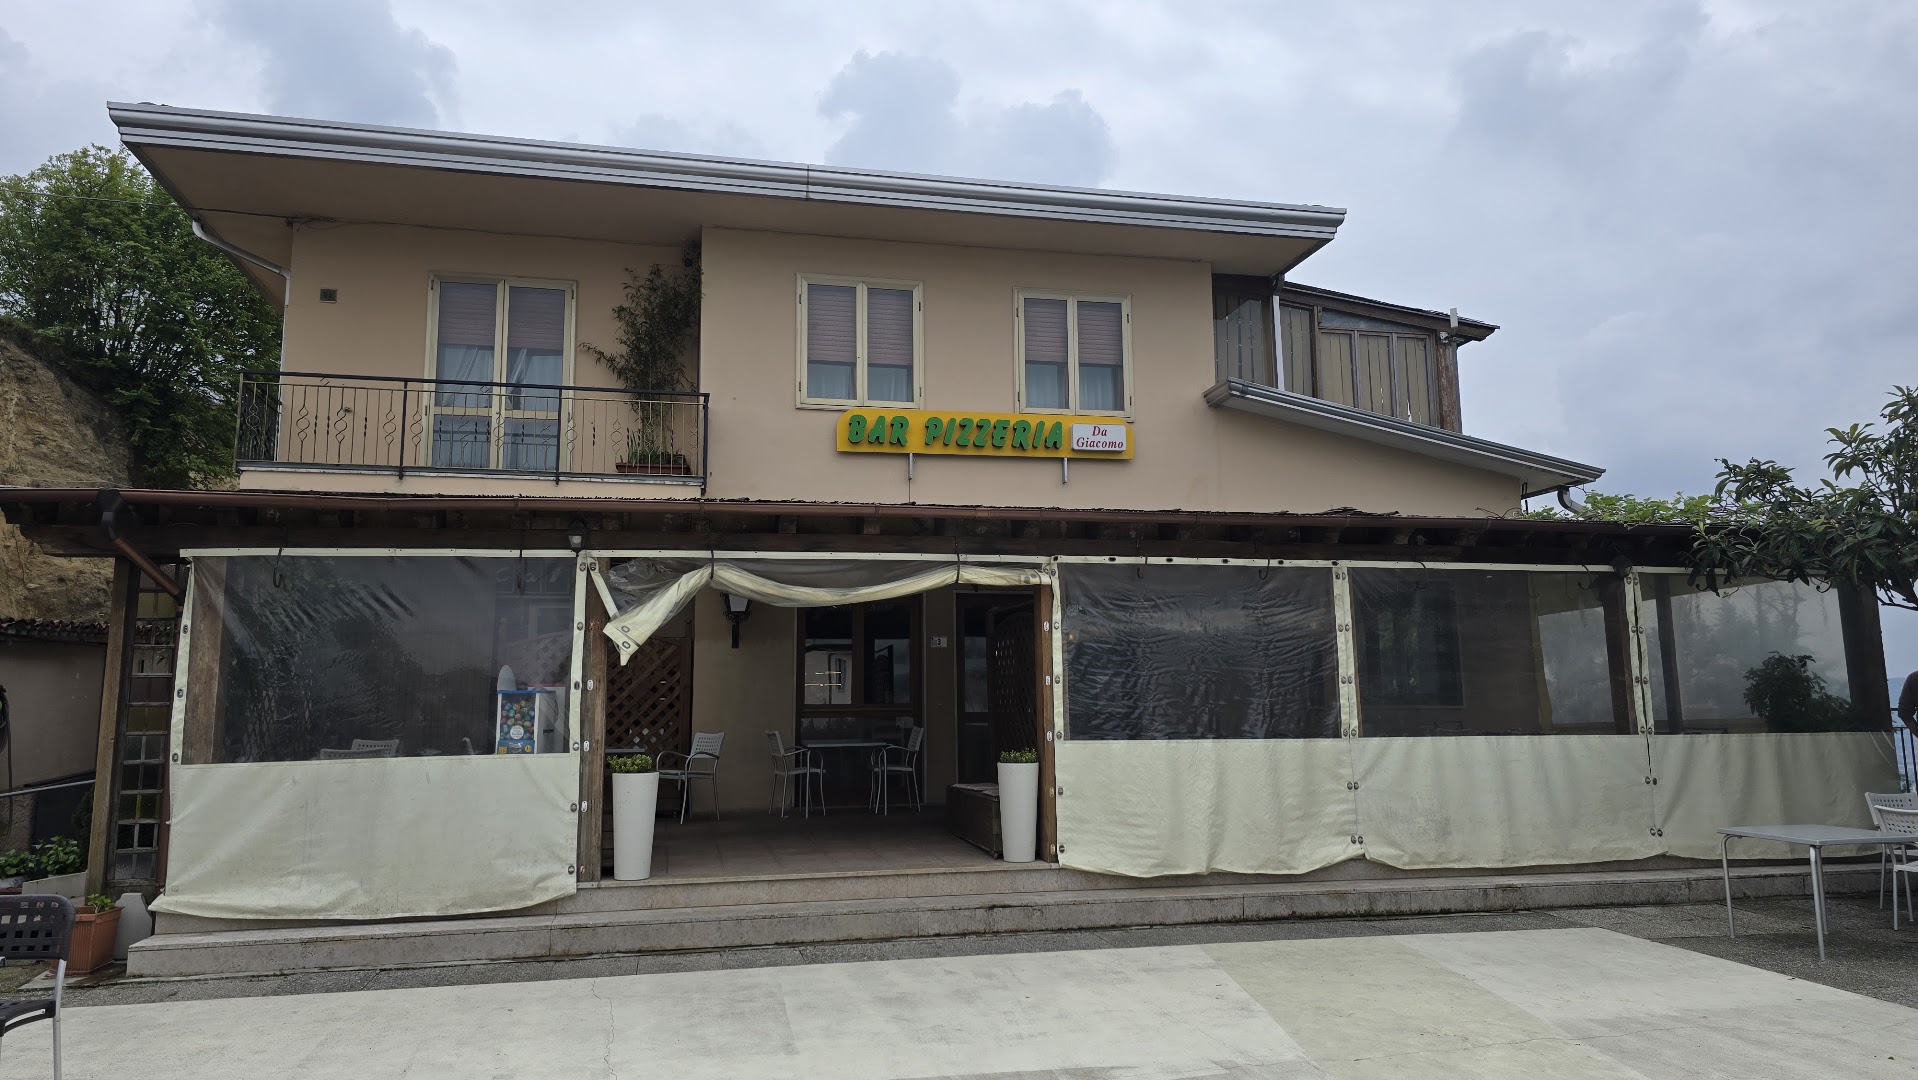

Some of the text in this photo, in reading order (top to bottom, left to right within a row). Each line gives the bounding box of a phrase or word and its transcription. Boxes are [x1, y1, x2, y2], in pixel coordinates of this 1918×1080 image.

[848, 414, 1063, 450] BAR PIZZERIA
[1092, 426, 1107, 437] Da
[1076, 437, 1124, 449] Giacomo
[937, 638, 942, 646] 3
